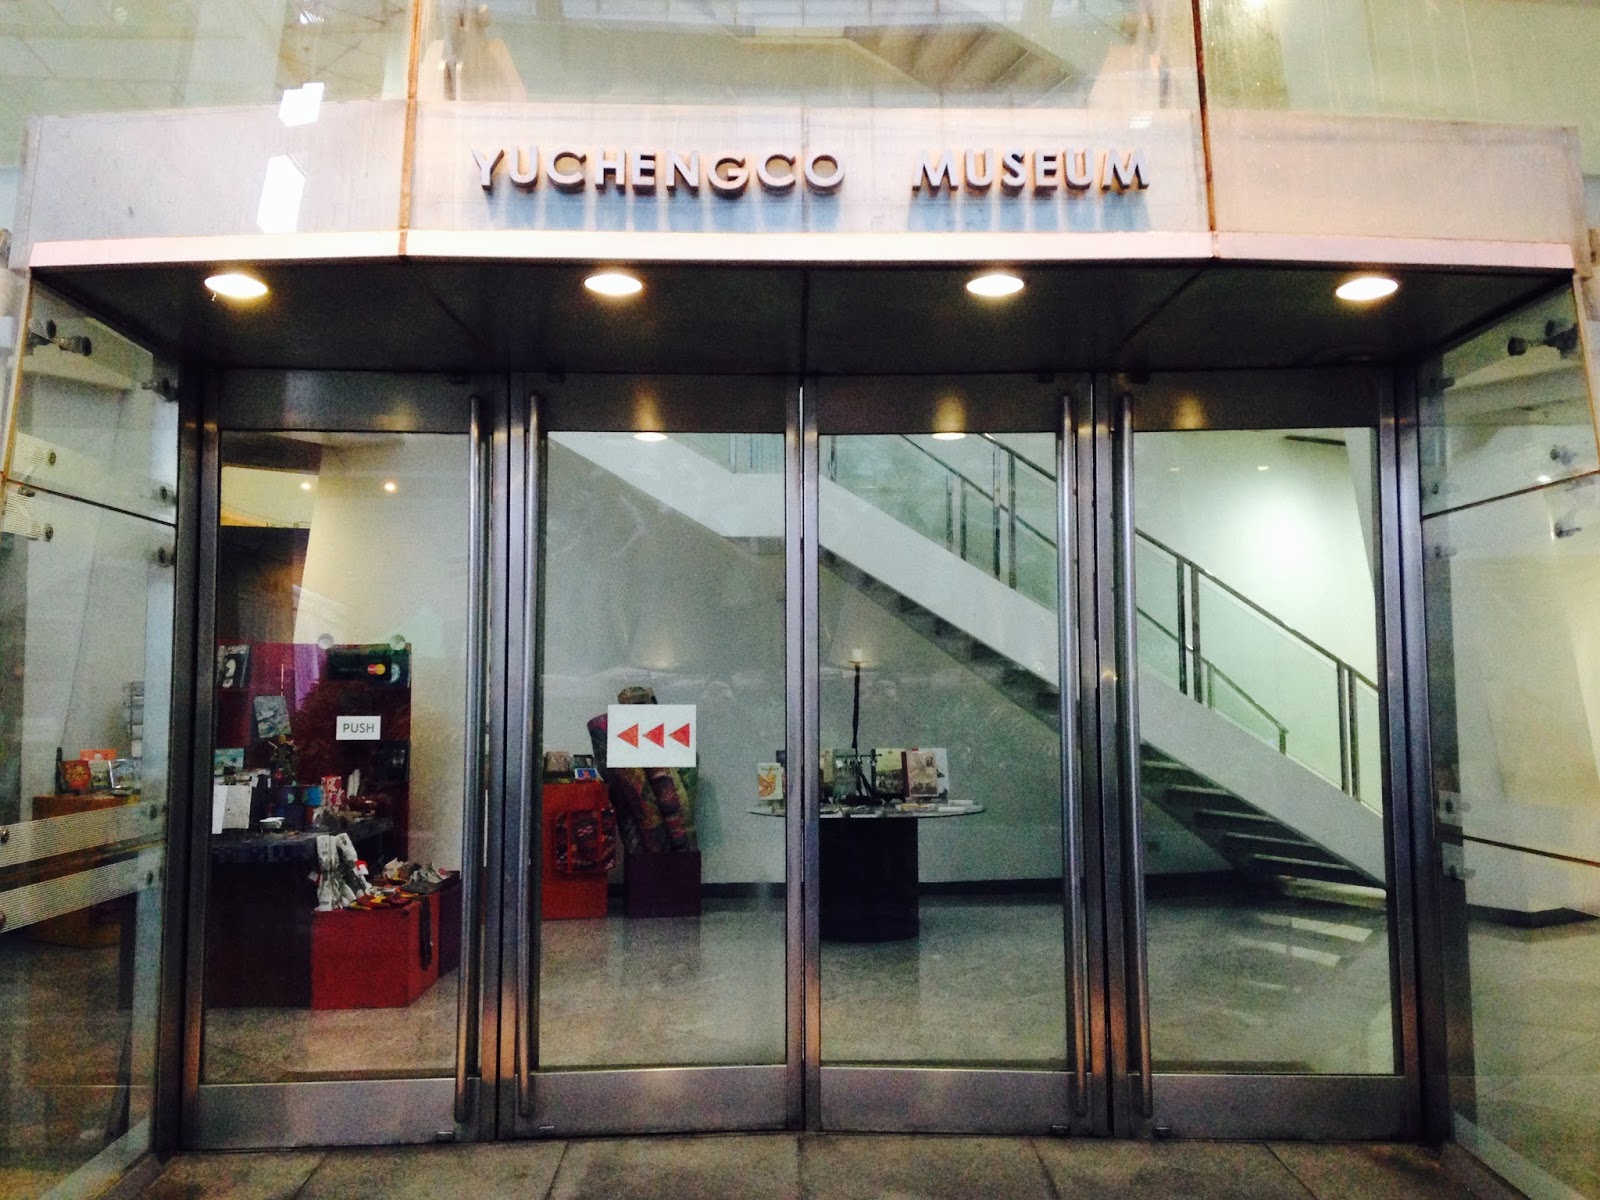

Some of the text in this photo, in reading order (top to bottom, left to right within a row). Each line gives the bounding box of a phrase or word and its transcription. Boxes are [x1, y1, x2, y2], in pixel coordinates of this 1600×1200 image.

[472, 147, 1150, 195] YUCHENGCO MUSEUM
[342, 722, 375, 734] PUSH
